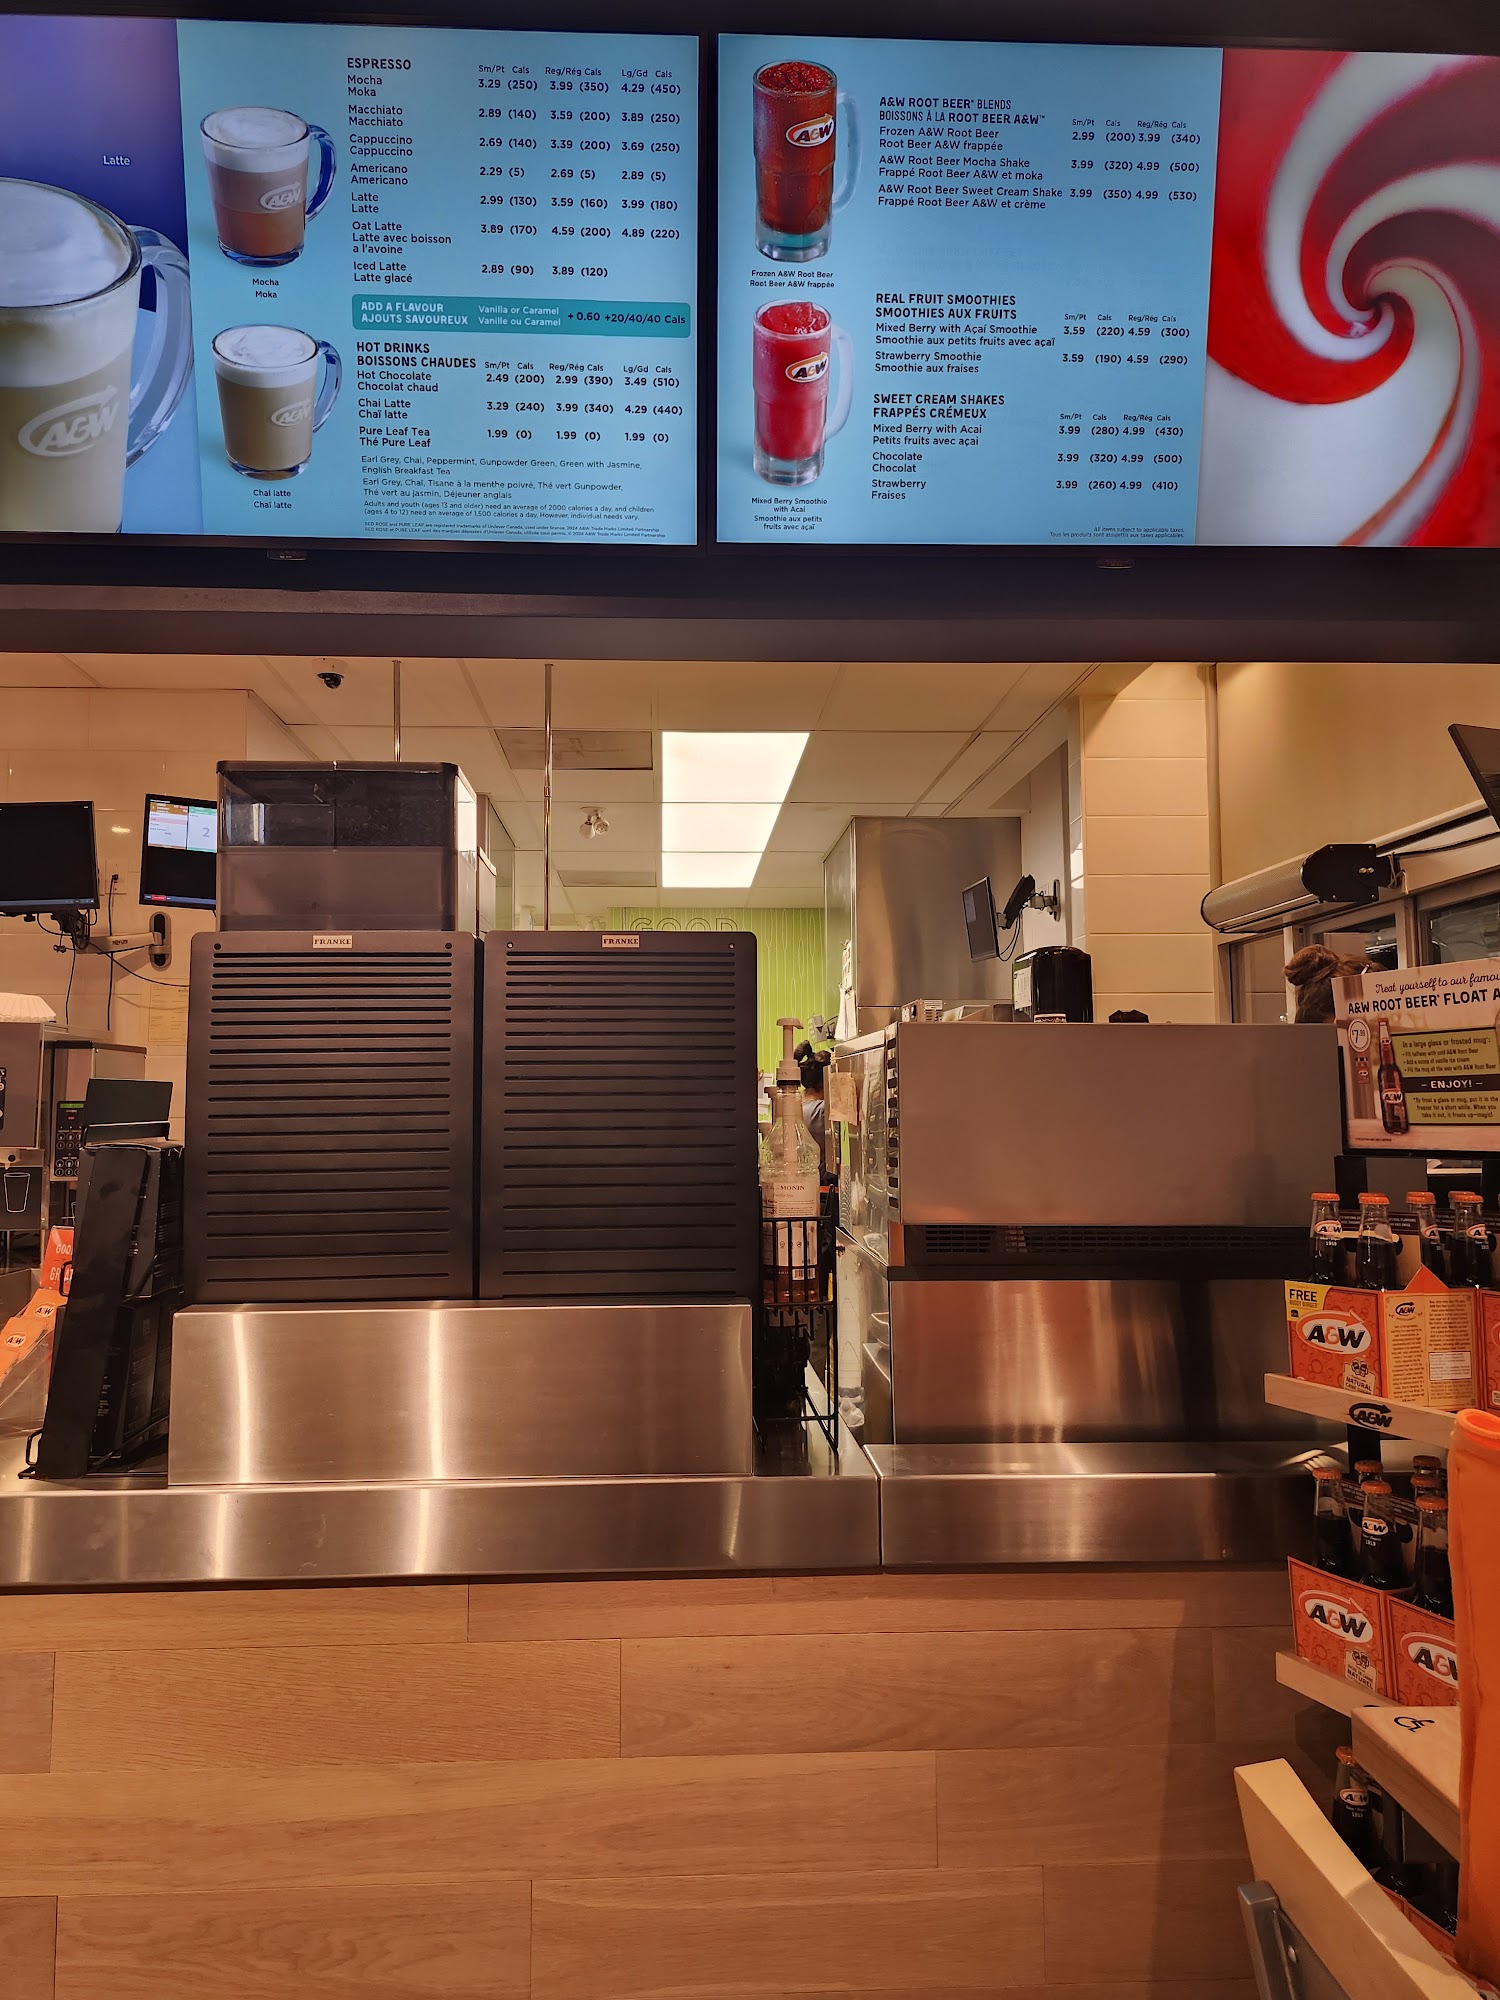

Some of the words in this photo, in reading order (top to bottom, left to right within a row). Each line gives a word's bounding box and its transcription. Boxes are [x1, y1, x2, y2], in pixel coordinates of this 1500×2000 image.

[347, 58, 411, 70] ESPRESSO
[478, 64, 505, 73] Sm/Pt
[545, 66, 581, 76] Reg/Rég
[622, 69, 648, 78] Lg/Gd
[348, 75, 382, 85] Mocha
[478, 79, 500, 88] 3.29
[508, 80, 537, 91] (250)
[348, 86, 376, 96] Moka
[550, 81, 573, 90] 3.99
[579, 82, 609, 93] (350)
[621, 83, 644, 92] 4.29
[651, 84, 680, 95] (450)
[880, 97, 905, 107] A&W
[909, 98, 939, 108] ROOT
[977, 99, 1011, 110] BLENDS
[349, 104, 403, 115] Macchiato
[794, 122, 832, 142] A&W
[880, 126, 914, 136] Frozen
[918, 127, 944, 136] A&W
[948, 128, 972, 137] Root
[976, 129, 999, 138] Beer
[880, 138, 904, 148] Root
[908, 139, 932, 148] Beer
[934, 140, 960, 149] A&W
[964, 140, 1003, 152] frappée
[104, 155, 130, 165] Latte
[352, 221, 371, 230] Oat
[375, 222, 402, 231] Latte
[353, 233, 380, 242] Latte
[411, 234, 451, 244] boisson
[362, 244, 402, 254] l'avoine
[876, 293, 905, 304] REAL
[909, 294, 944, 304] FRUIT
[947, 294, 1016, 305] SMOOTHIES
[361, 302, 383, 311] ADD
[386, 302, 392, 311] A
[396, 302, 443, 312] FLAVOUR
[523, 306, 559, 314] Caramel
[876, 307, 944, 318] SMOOTHIES
[948, 308, 971, 318] AUX
[975, 309, 1016, 319] FRUITS
[357, 342, 380, 352] HOT
[384, 342, 430, 353] DRINKS
[357, 356, 417, 366] BOISSONS
[421, 357, 476, 368] CHAUDES
[875, 351, 930, 362] Strawberry
[934, 352, 982, 361] Smoothie
[1062, 354, 1084, 362] 3.59
[1095, 354, 1122, 364] (190)
[1127, 355, 1148, 364] 4.59
[1160, 355, 1188, 366] (290)
[792, 358, 827, 378] A&W
[357, 370, 376, 379] Hot
[379, 370, 432, 380] Chocolate
[358, 381, 404, 391] Chocolat
[407, 382, 438, 392] chaud
[874, 394, 912, 404] SWEET
[916, 394, 956, 406] CREAM
[960, 395, 1004, 405] SHAKES
[874, 405, 926, 418] FRAPPÉS
[930, 406, 986, 418] CRÉMEUX
[38, 402, 120, 449] A&W
[872, 452, 922, 460] Chocolate
[362, 466, 392, 474] English
[394, 466, 434, 474] Breakfast
[872, 463, 916, 472] Chocolat
[872, 479, 926, 490] Strawberry
[872, 490, 906, 500] Fraises
[795, 498, 827, 506] Smoothie
[202, 828, 210, 837] 2
[1376, 983, 1396, 993] Treat
[1400, 978, 1437, 994] yourself
[1438, 978, 1448, 987] to
[1451, 976, 1467, 985] our
[1348, 1001, 1370, 1014] A&W
[1373, 998, 1402, 1012] ROOT
[1444, 989, 1488, 1005] FLOAT
[1413, 1040, 1426, 1049] large
[1430, 1079, 1472, 1089] ENJOY!
[56, 1244, 73, 1255] GOO
[50, 1266, 74, 1281] GRAT
[1289, 1289, 1317, 1302] FREE
[1306, 1325, 1365, 1348] A&W
[1346, 1376, 1372, 1391] NATURAL
[1356, 1410, 1392, 1428] A&W
[1310, 1603, 1367, 1638] A&W
[1413, 1646, 1458, 1680] A&
[1347, 1668, 1373, 1690] NATUREL
